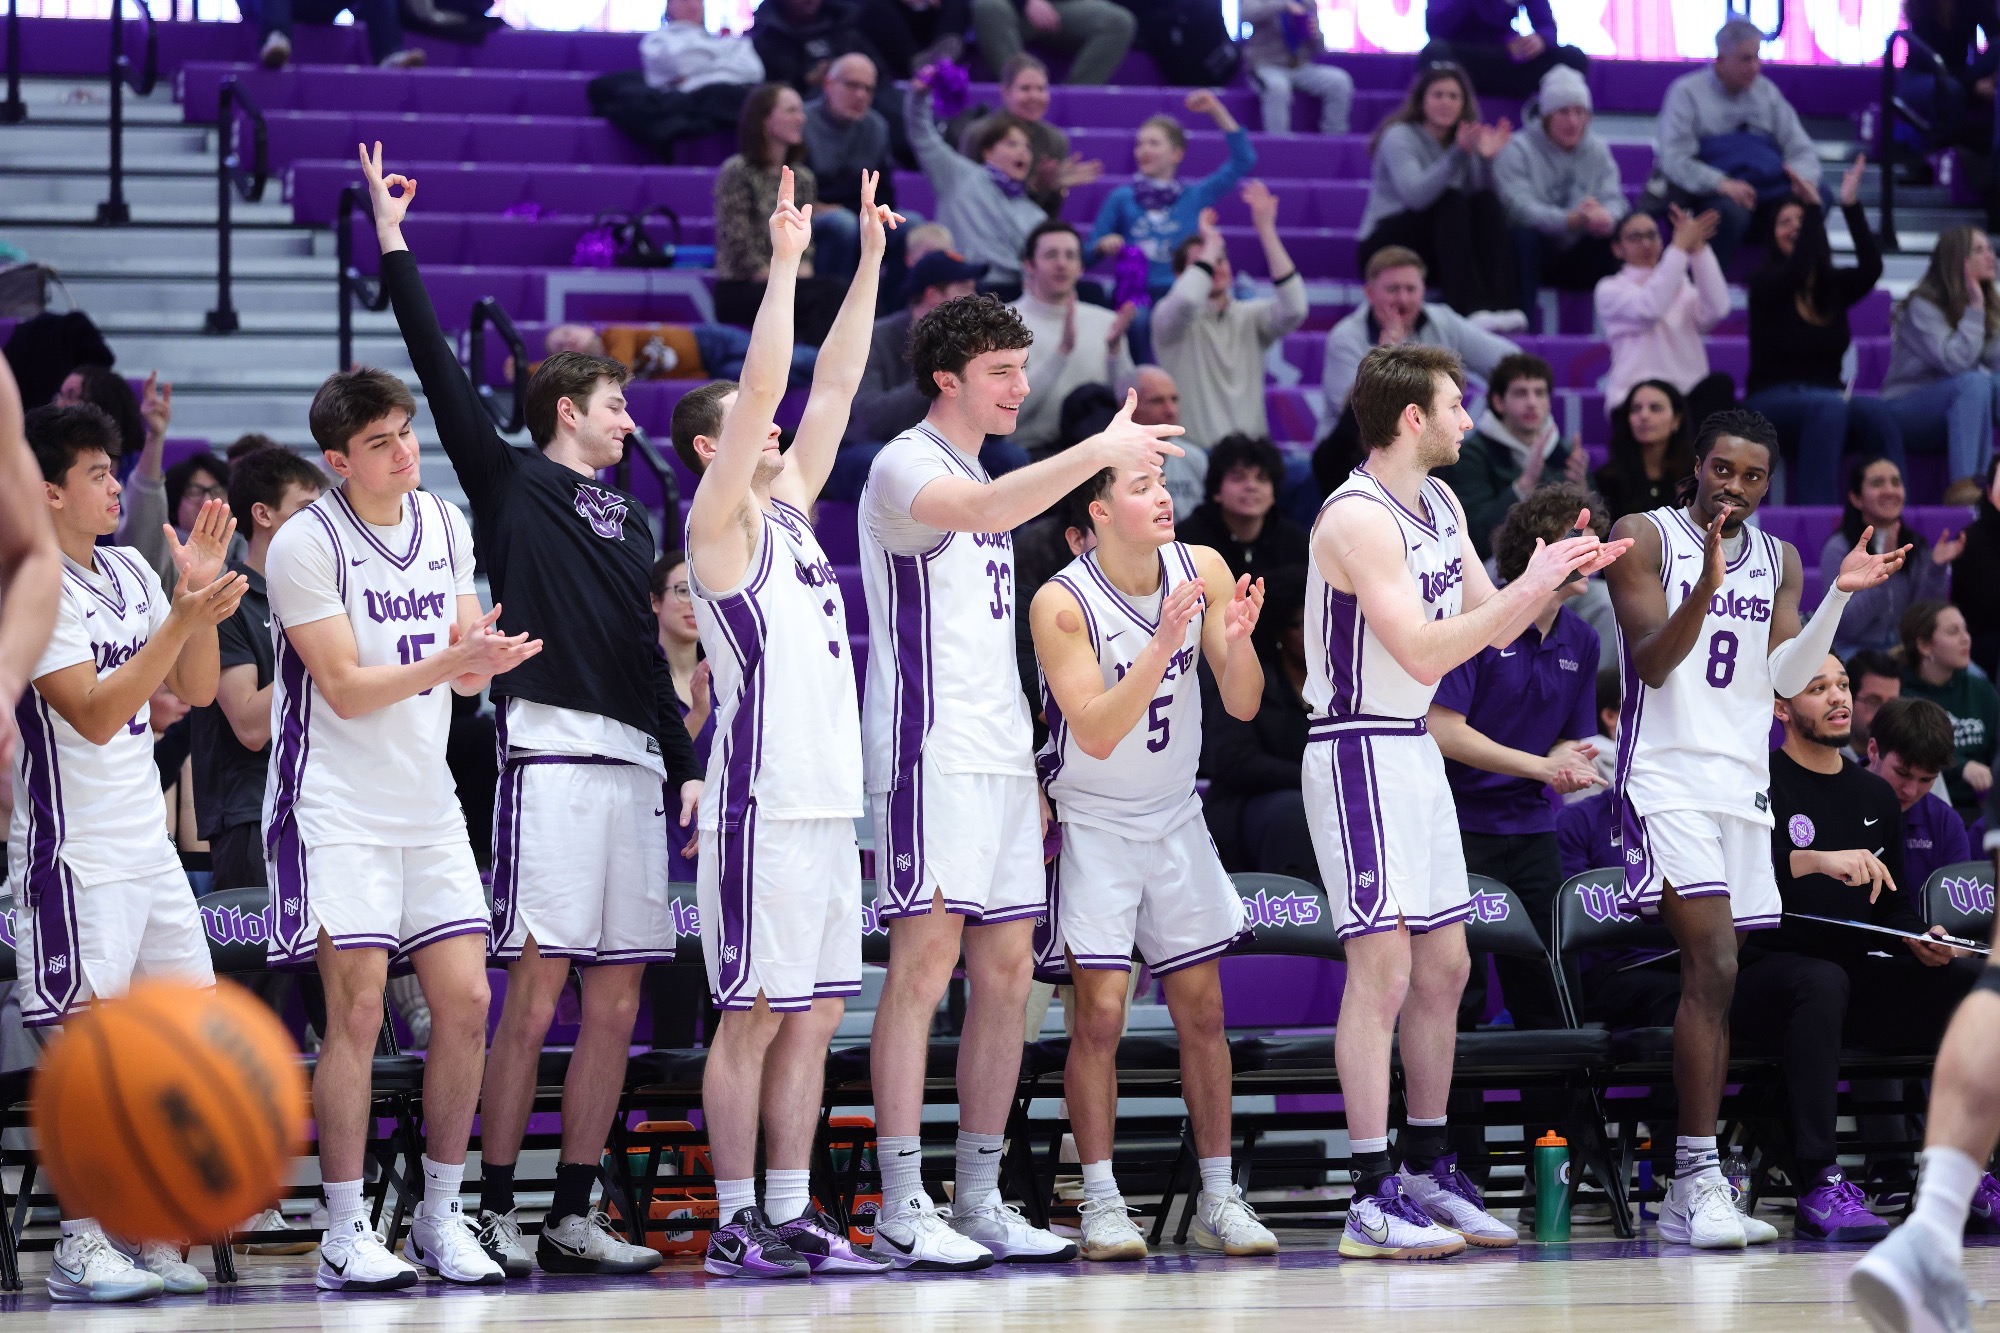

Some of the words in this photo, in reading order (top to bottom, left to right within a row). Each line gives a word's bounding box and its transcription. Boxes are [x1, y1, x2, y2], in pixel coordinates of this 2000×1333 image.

[1679, 579, 1771, 623] olets
[1705, 629, 1739, 690] 8
[1146, 693, 1174, 754] 5
[1242, 887, 1322, 929] olets
